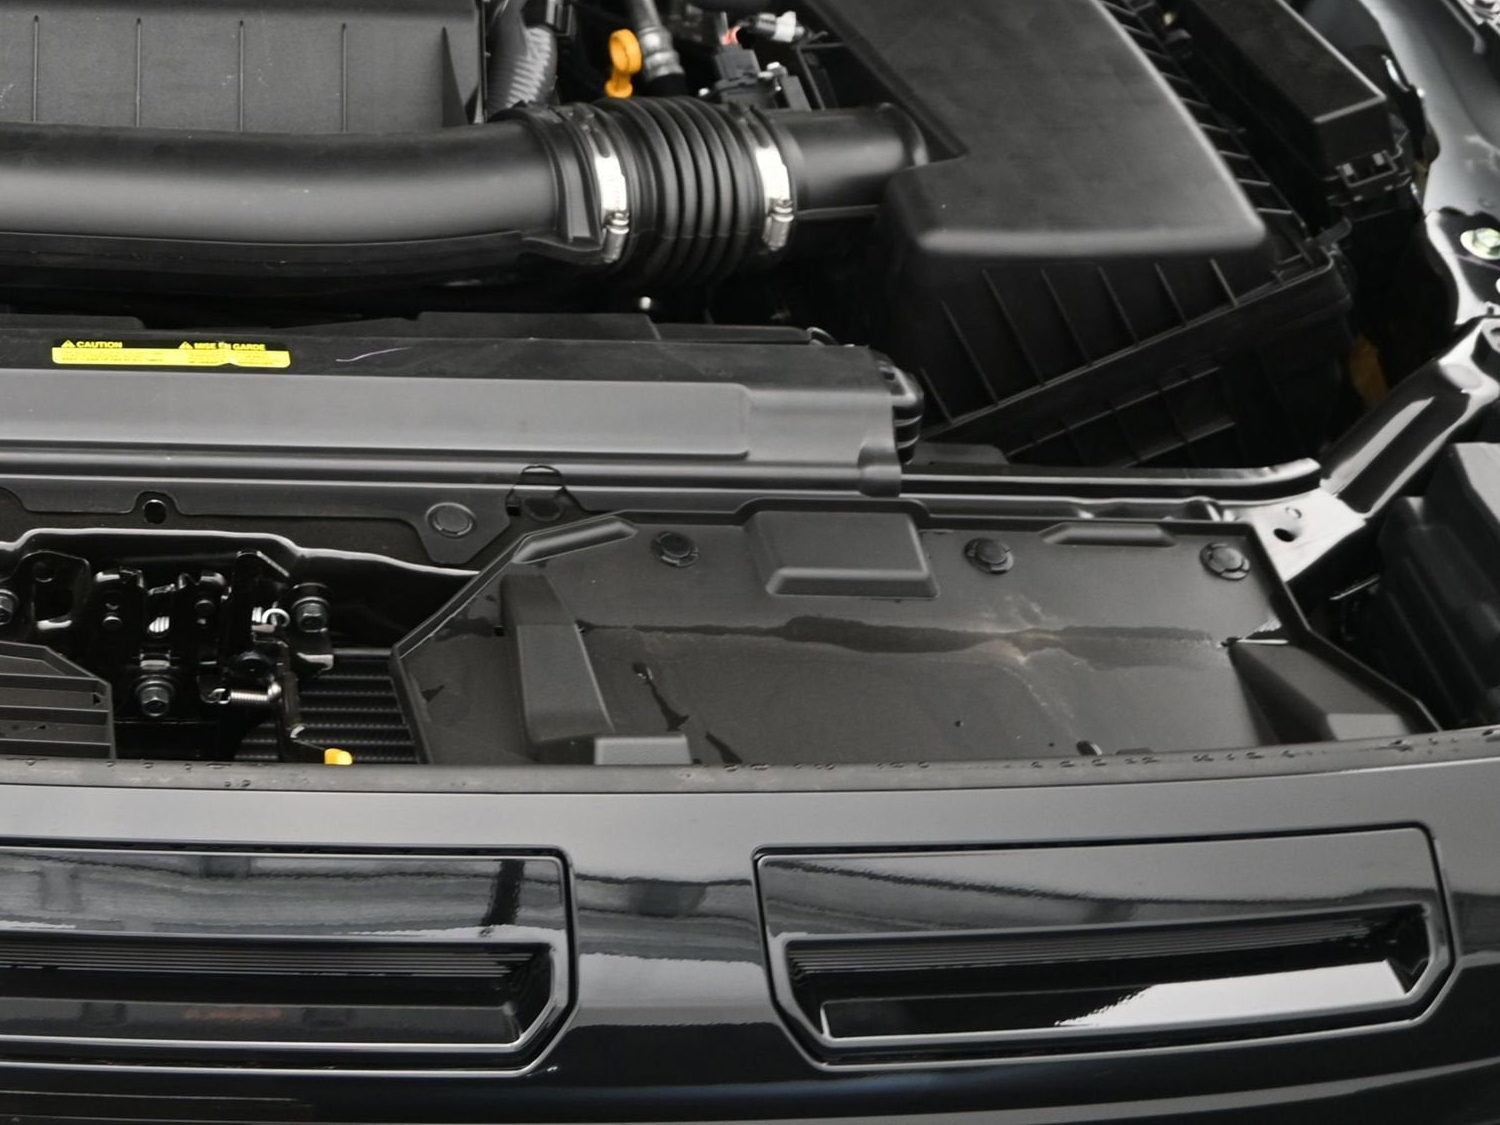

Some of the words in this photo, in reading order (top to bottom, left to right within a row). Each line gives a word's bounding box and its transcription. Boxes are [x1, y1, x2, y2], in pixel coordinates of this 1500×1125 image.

[76, 341, 123, 349] CAUTION
[193, 342, 217, 350] MISE
[232, 343, 266, 351] GARDE
